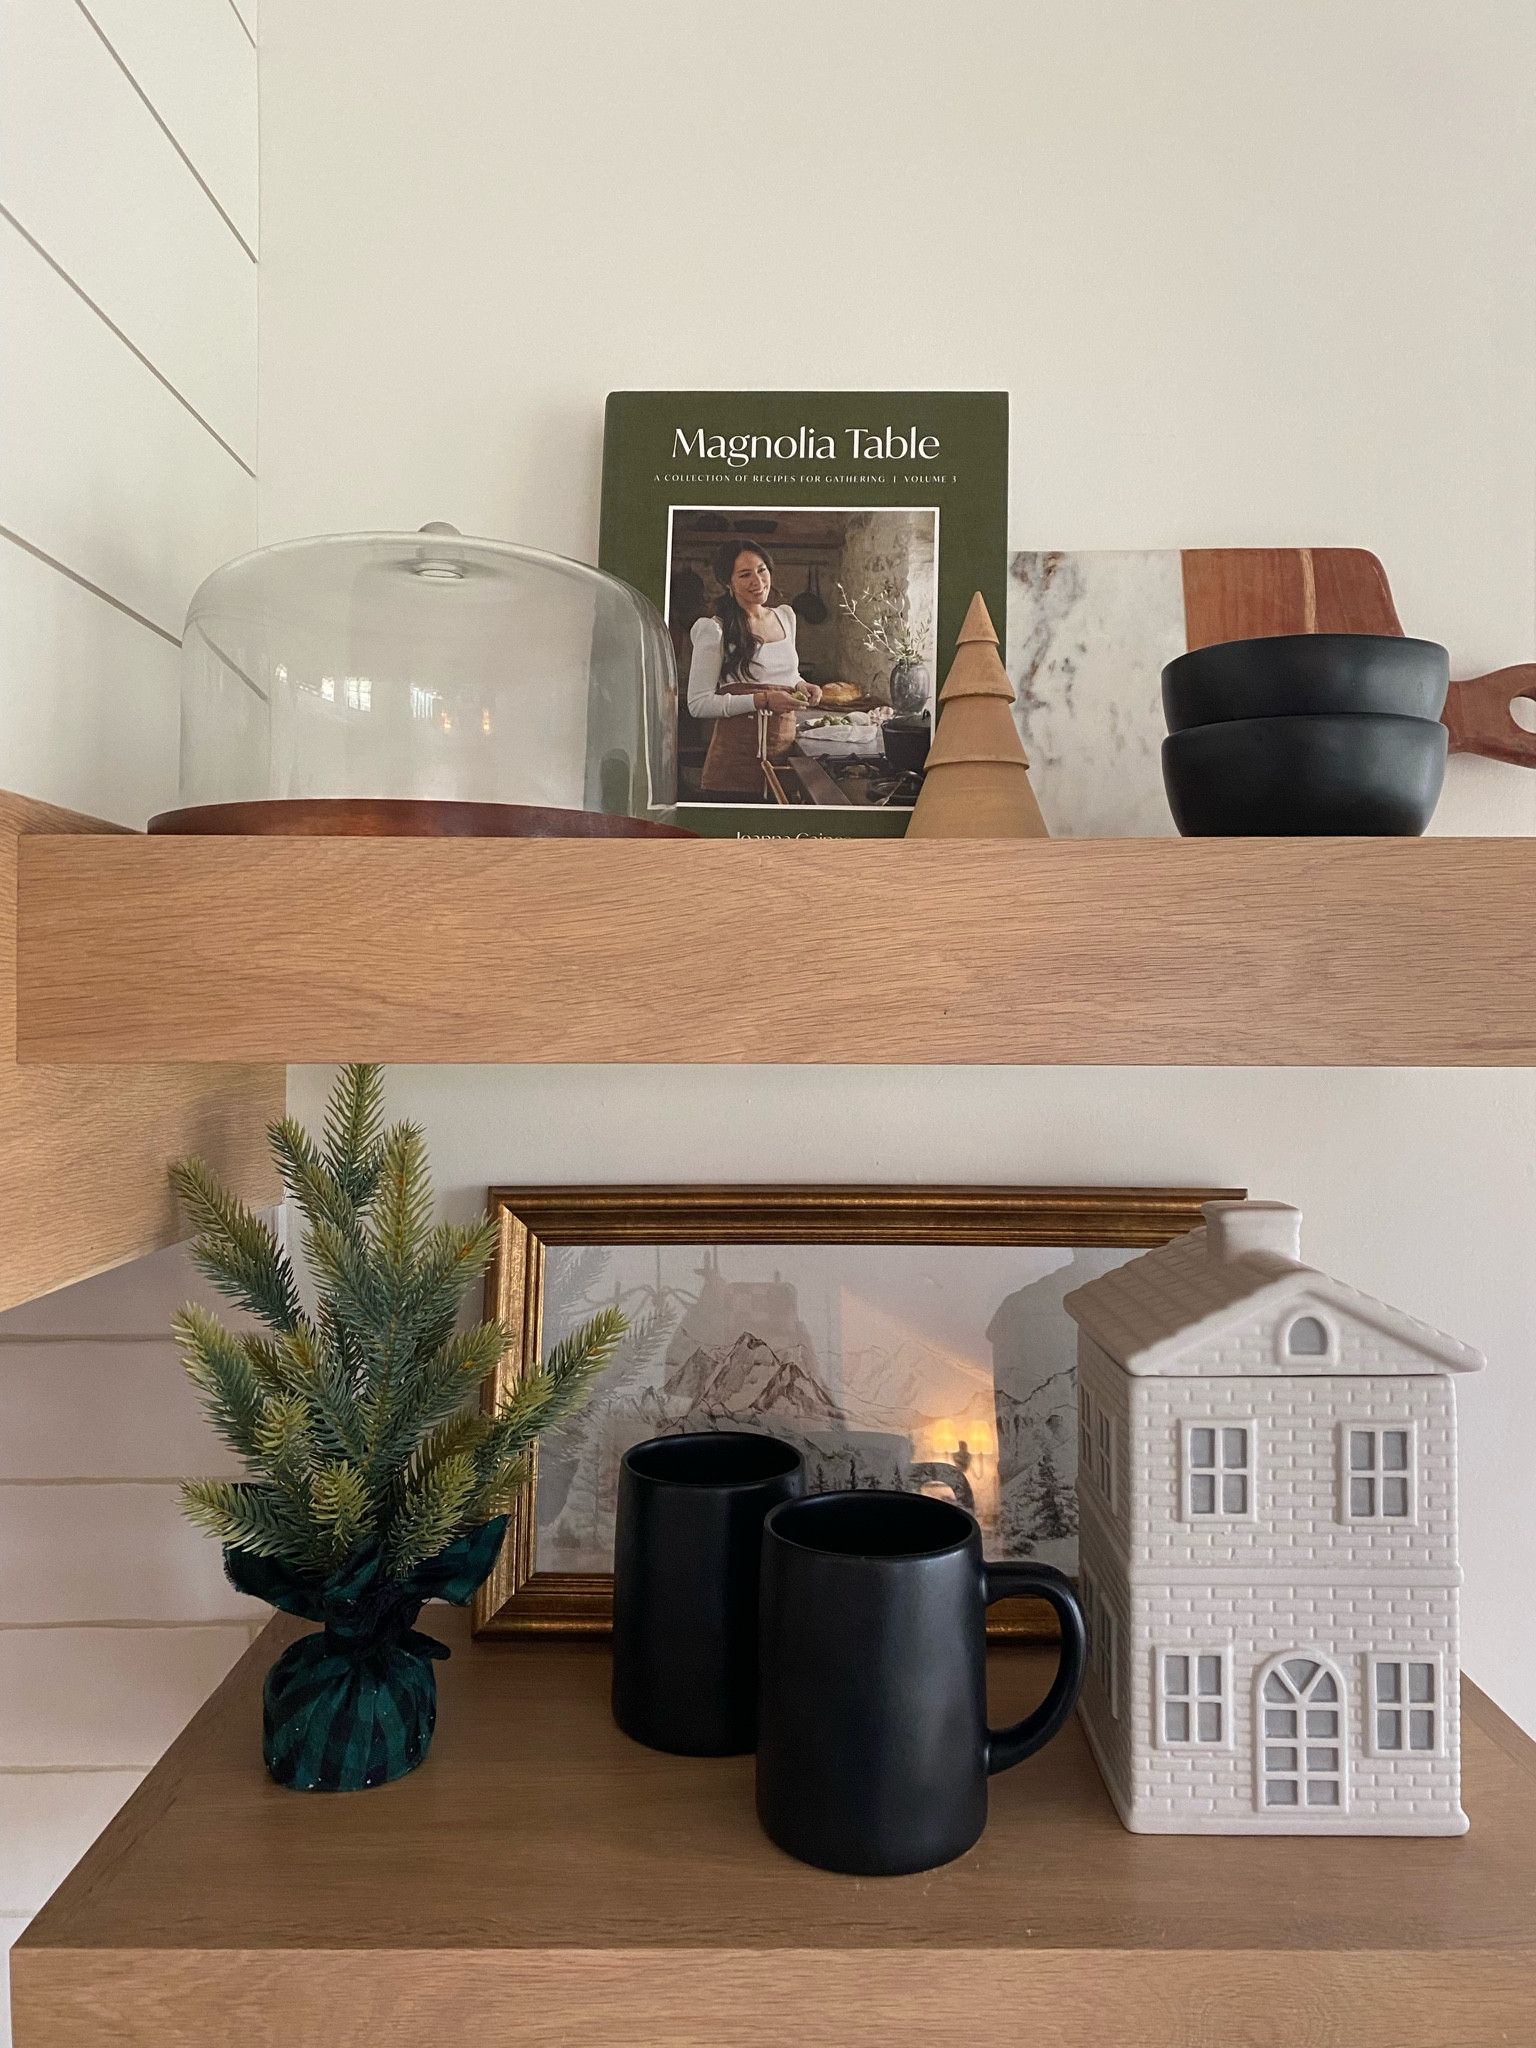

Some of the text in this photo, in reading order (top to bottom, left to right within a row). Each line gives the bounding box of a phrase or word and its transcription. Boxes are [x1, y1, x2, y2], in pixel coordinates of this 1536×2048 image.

[671, 425, 941, 468] Magnolia Table
[653, 474, 661, 482] A
[664, 474, 731, 482] COLLECTION
[734, 474, 749, 483] OF
[752, 474, 796, 483] RECIPES
[800, 475, 821, 483] FOR
[825, 475, 886, 483] GATHERING
[904, 475, 947, 483] VOLUME
